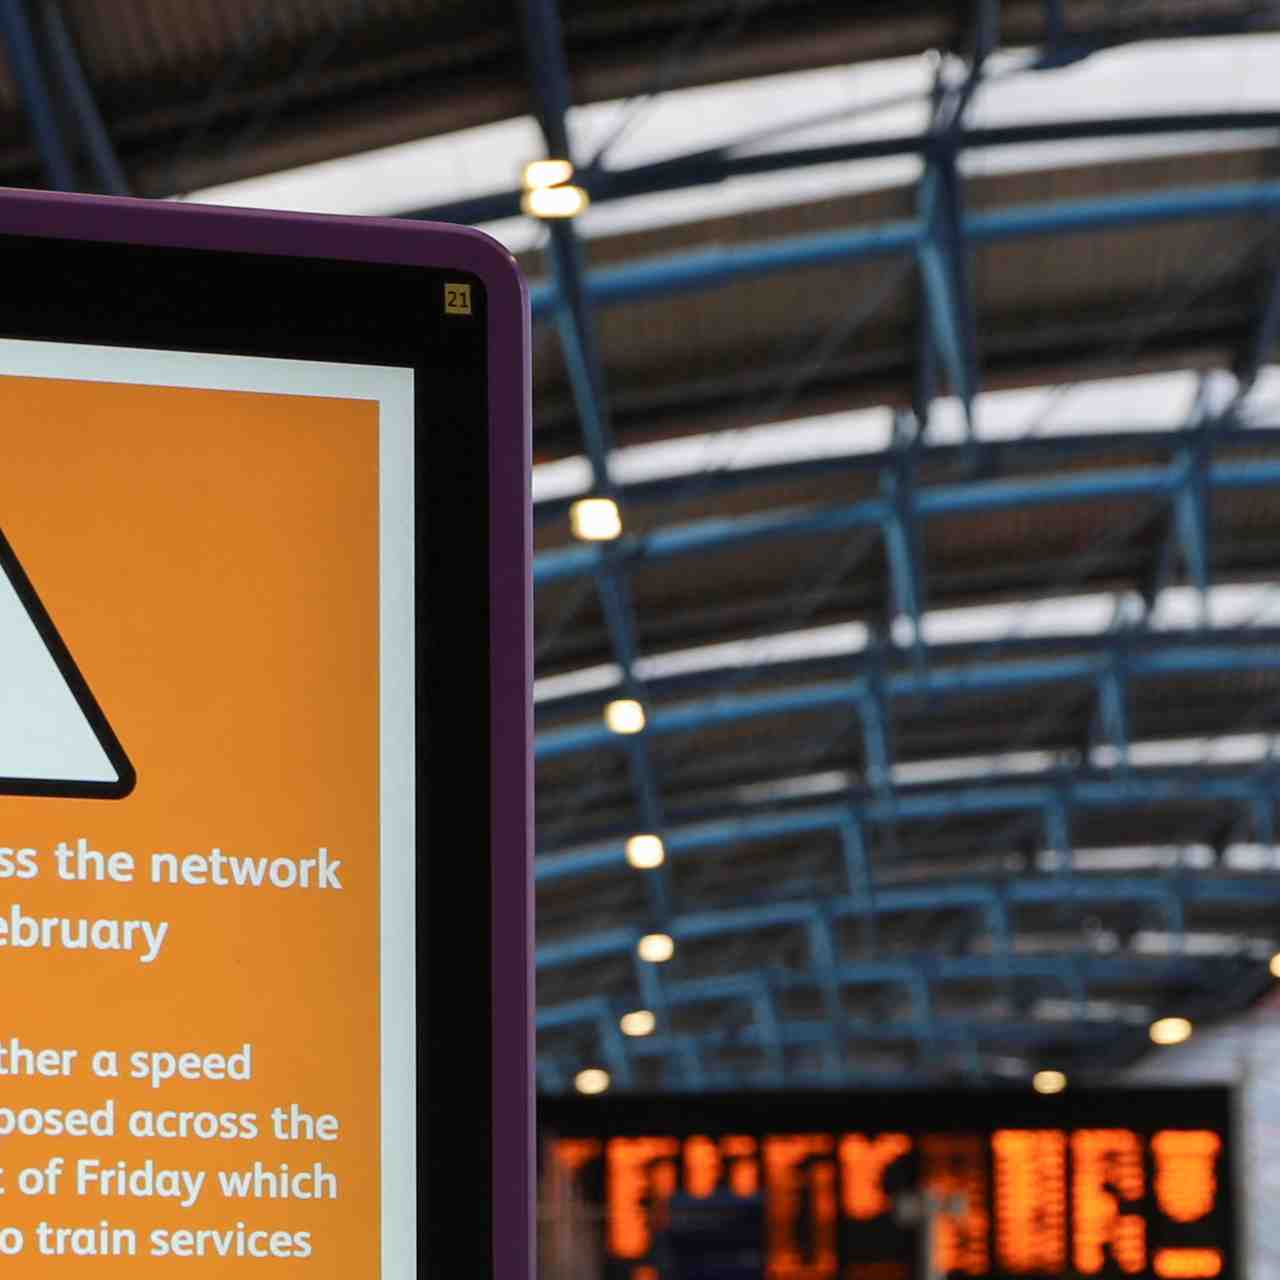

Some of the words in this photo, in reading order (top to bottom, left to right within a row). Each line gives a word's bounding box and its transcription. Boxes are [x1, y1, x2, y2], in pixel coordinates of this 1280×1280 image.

[447, 291, 469, 308] 21
[53, 838, 135, 883] the
[151, 847, 343, 890] network
[91, 1050, 119, 1078] a
[130, 1043, 252, 1089] speed
[128, 1110, 259, 1140] across
[270, 1103, 339, 1141] the
[18, 1156, 65, 1196] of
[76, 1159, 206, 1208] Friday
[217, 1161, 337, 1200] which
[35, 1220, 137, 1256] train
[149, 1221, 312, 1258] services
